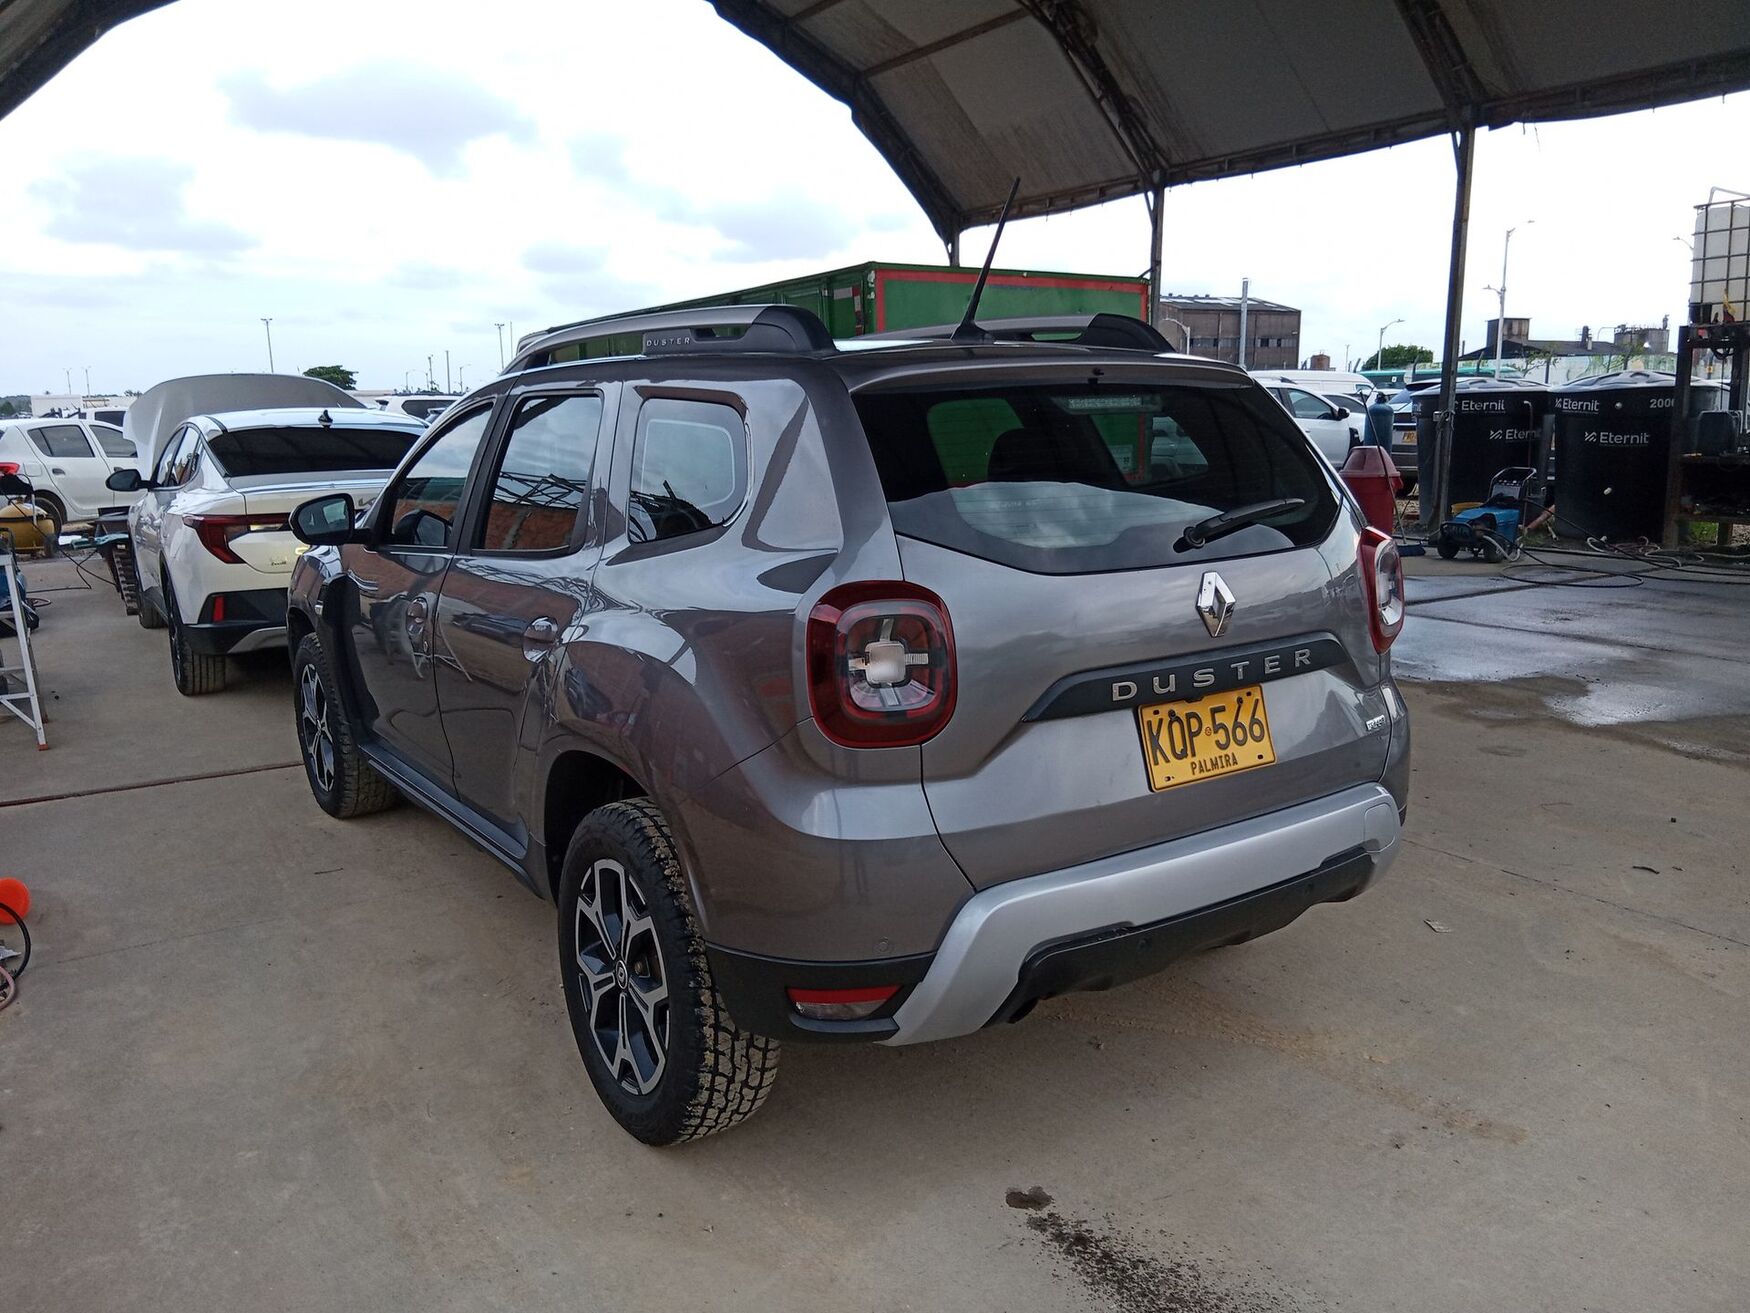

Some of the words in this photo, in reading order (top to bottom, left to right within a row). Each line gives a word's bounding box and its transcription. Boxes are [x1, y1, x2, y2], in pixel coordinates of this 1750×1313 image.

[646, 337, 690, 347] DUSTER
[1461, 400, 1505, 411] Eternit
[1562, 398, 1600, 411] Eternit
[1599, 432, 1650, 444] Eternit
[1112, 648, 1312, 702] DUSTER
[1190, 752, 1238, 775] PALMIRA
